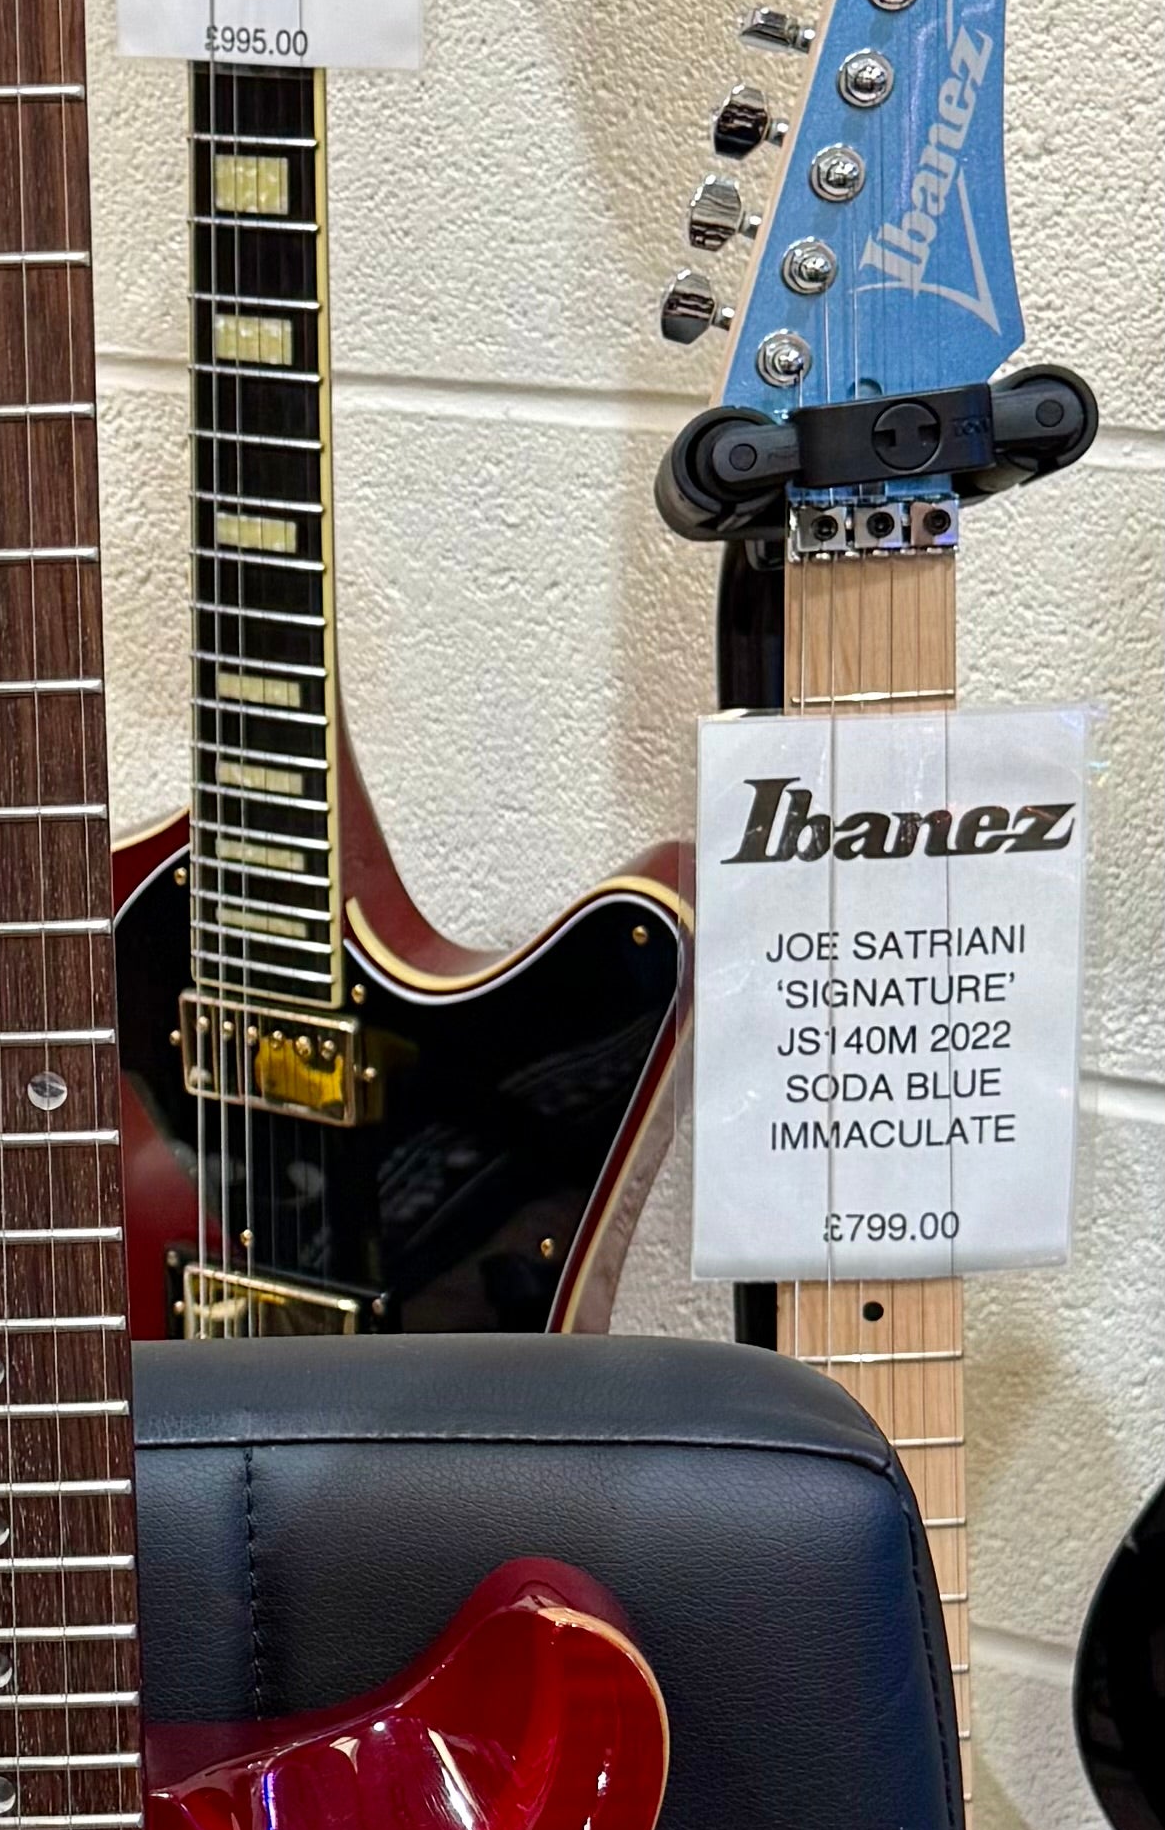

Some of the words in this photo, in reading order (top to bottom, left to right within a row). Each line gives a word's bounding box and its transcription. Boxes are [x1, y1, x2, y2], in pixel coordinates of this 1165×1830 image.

[204, 25, 309, 57] £995.00
[859, 24, 994, 299] Ibanez
[720, 776, 1077, 865] Ibanez
[765, 932, 840, 964] JOE
[852, 924, 1026, 962] SATRIANI
[777, 1024, 918, 1057] JS140M
[930, 1019, 1012, 1053] 2022
[786, 1072, 894, 1103] SODA
[906, 1067, 1002, 1101] BLUE
[770, 1113, 1017, 1151] IMMACULATE
[822, 1210, 960, 1243] £799.00
